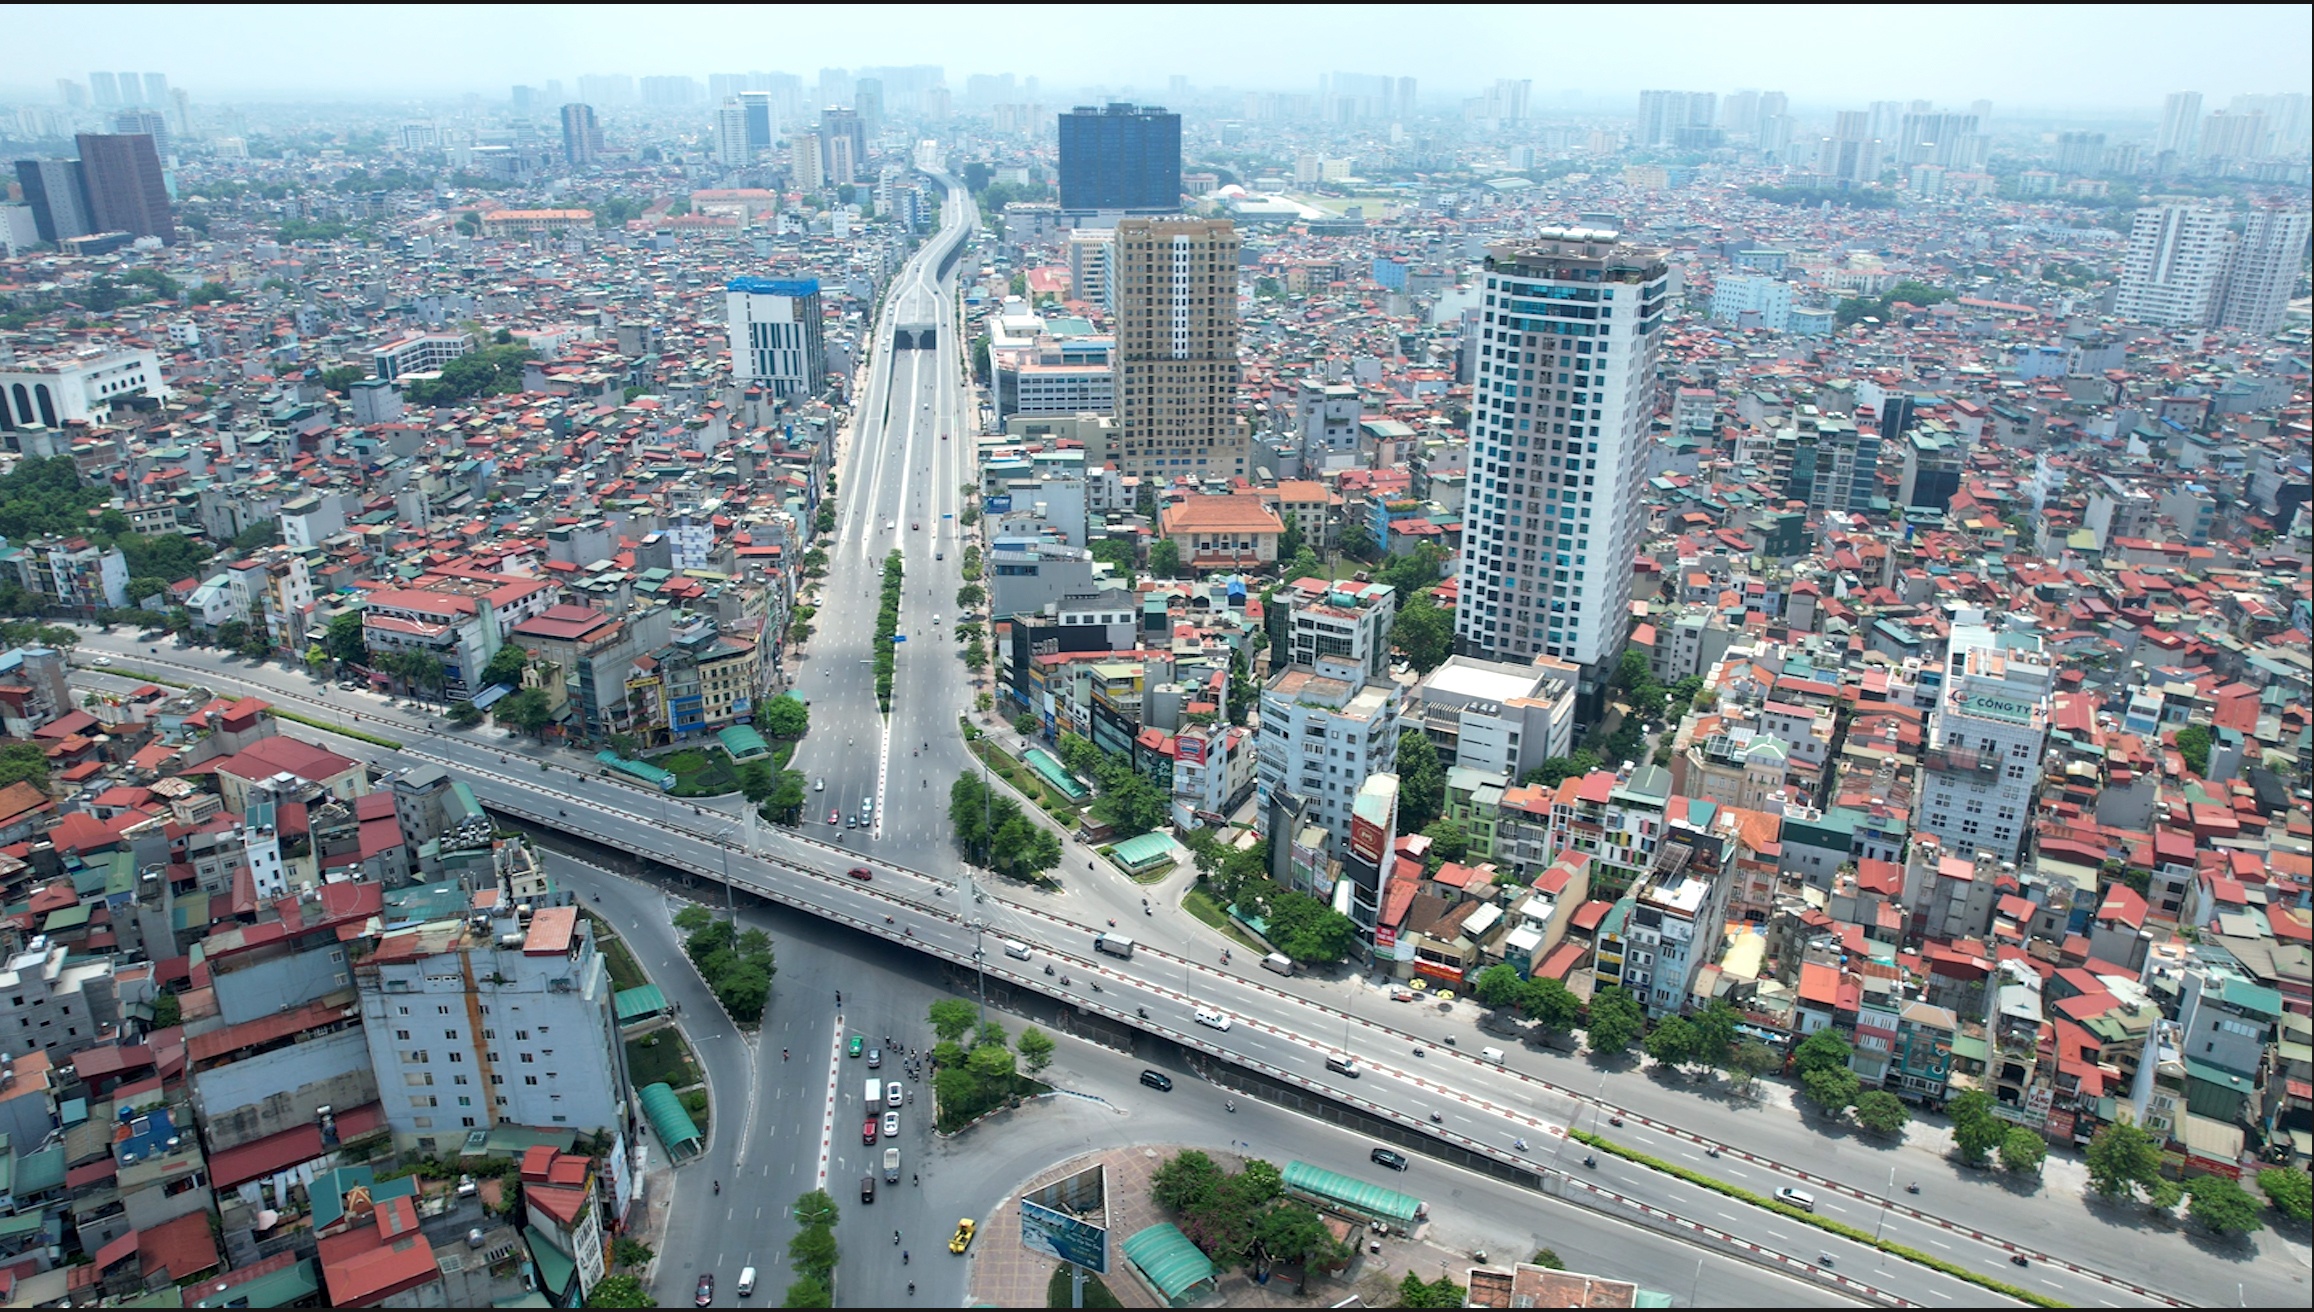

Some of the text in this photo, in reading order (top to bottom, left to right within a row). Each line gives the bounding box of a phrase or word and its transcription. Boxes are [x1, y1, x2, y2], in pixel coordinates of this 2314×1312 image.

[1977, 698, 2013, 711] CÔNG
[2016, 705, 2031, 714] TY
[2034, 708, 2048, 717] 29
